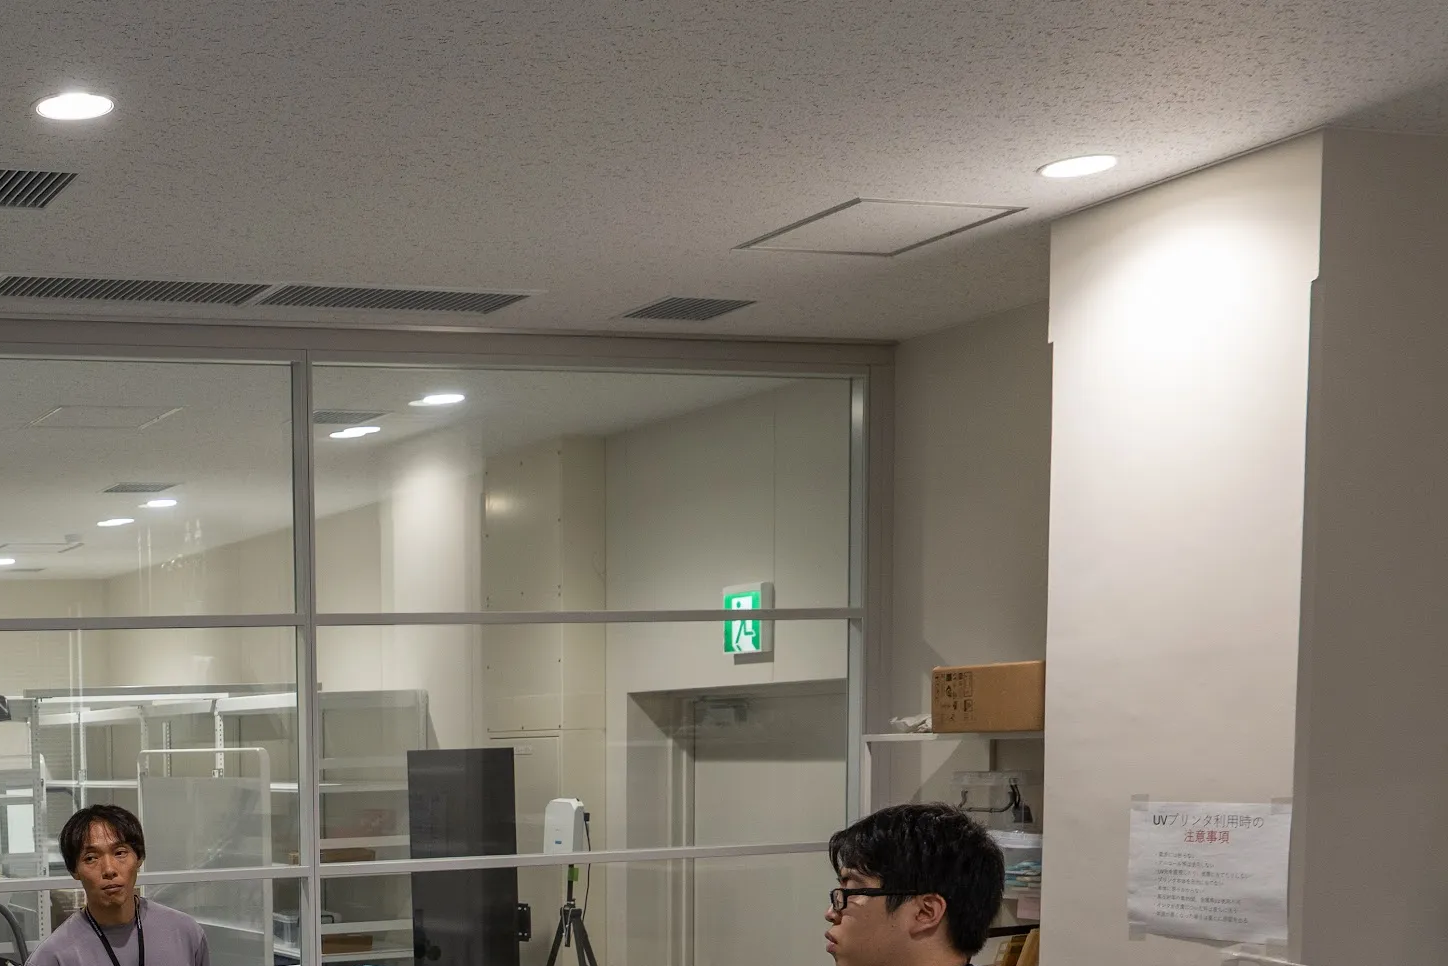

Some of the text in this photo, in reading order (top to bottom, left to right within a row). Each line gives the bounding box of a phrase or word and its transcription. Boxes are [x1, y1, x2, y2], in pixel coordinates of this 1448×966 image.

[1153, 813, 1265, 829] UVプリンタ利用時の
[1184, 829, 1230, 844] 注意事項
